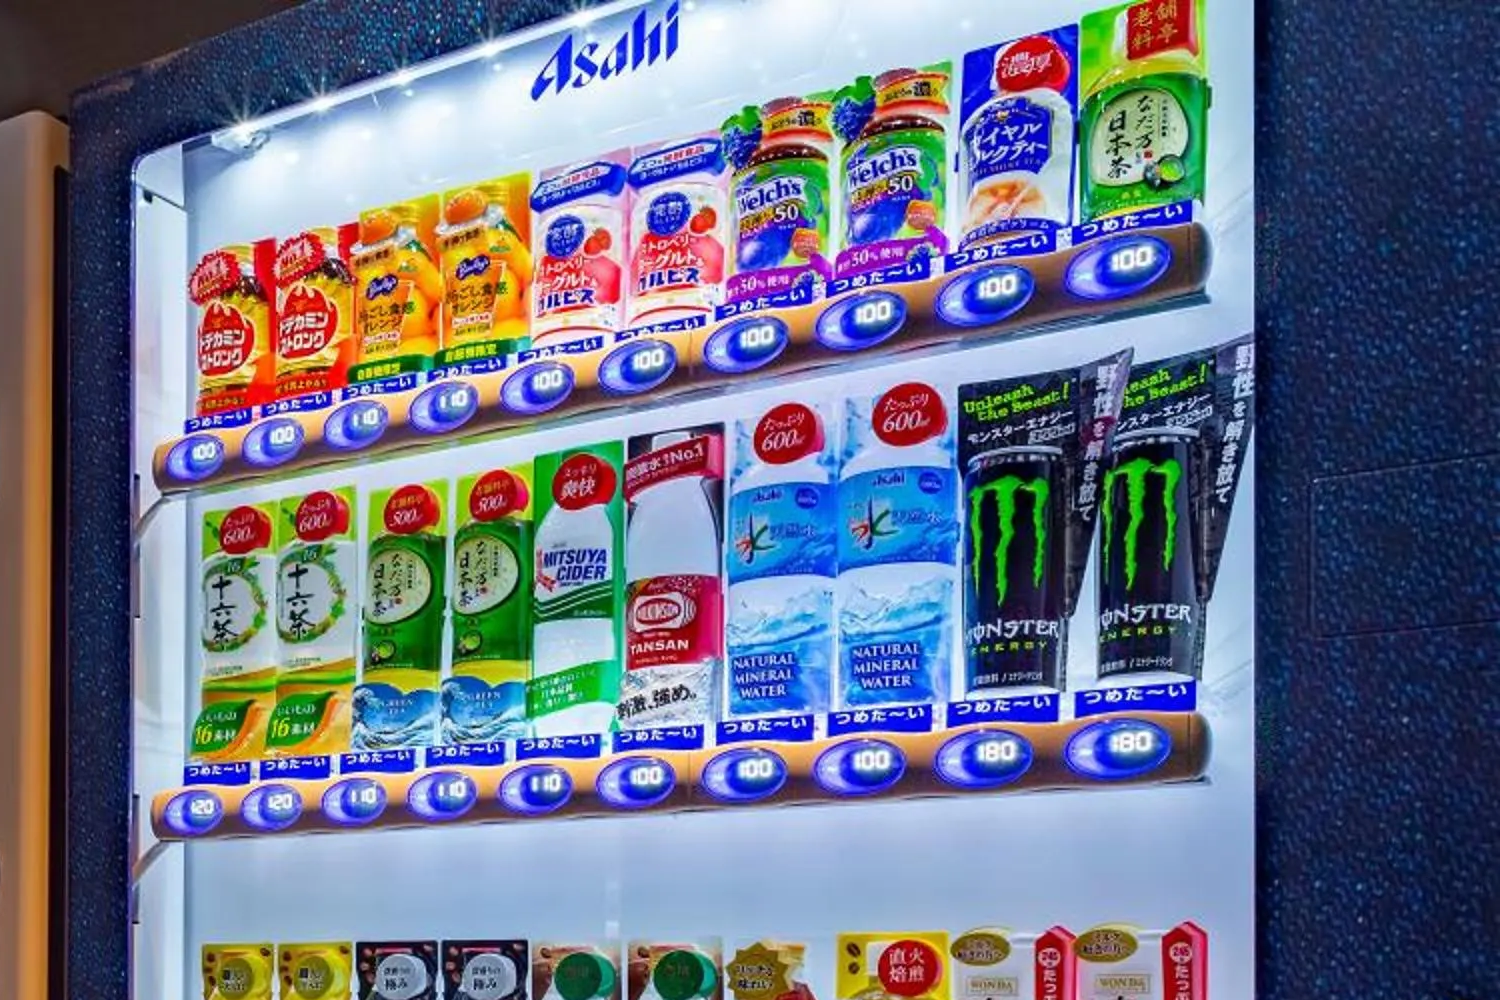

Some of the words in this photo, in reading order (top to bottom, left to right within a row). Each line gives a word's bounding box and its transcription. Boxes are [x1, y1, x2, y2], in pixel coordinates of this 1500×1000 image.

[531, 1, 680, 101] Asahi
[1106, 110, 1132, 179] 日本茶
[887, 175, 913, 193] 50
[774, 205, 798, 222] 50
[1112, 247, 1152, 269] 100
[979, 276, 1016, 297] 100
[855, 302, 891, 323] 100
[740, 326, 774, 346] 100
[634, 350, 664, 368] 100
[534, 372, 562, 389] 100
[440, 391, 468, 407] 110
[353, 409, 378, 425] 110
[1116, 394, 1211, 429] ンスターエナジー
[270, 427, 294, 443] 100
[192, 443, 215, 459] 100
[544, 548, 606, 569] MITSUYA
[556, 565, 606, 581] CIDER
[287, 564, 315, 638] 十六茶
[212, 575, 237, 649] 十六茶
[631, 638, 689, 655] TANSAN
[853, 643, 919, 659] NATURAL
[733, 653, 795, 669] NATURAL
[853, 659, 918, 674] MINERAL
[735, 670, 794, 684] MINERAL
[861, 675, 913, 688] WATER
[741, 684, 787, 697] WATER
[1112, 731, 1151, 752] 180
[854, 750, 890, 770] 100
[979, 741, 1015, 763] 180
[631, 767, 662, 785] 100
[738, 758, 773, 779] 100
[438, 782, 466, 797] 110
[531, 775, 560, 792] 110
[269, 794, 293, 810] 120
[350, 788, 376, 803] 110
[191, 799, 214, 815] 120
[888, 949, 925, 963] 直火
[889, 966, 925, 983] 焙煎
